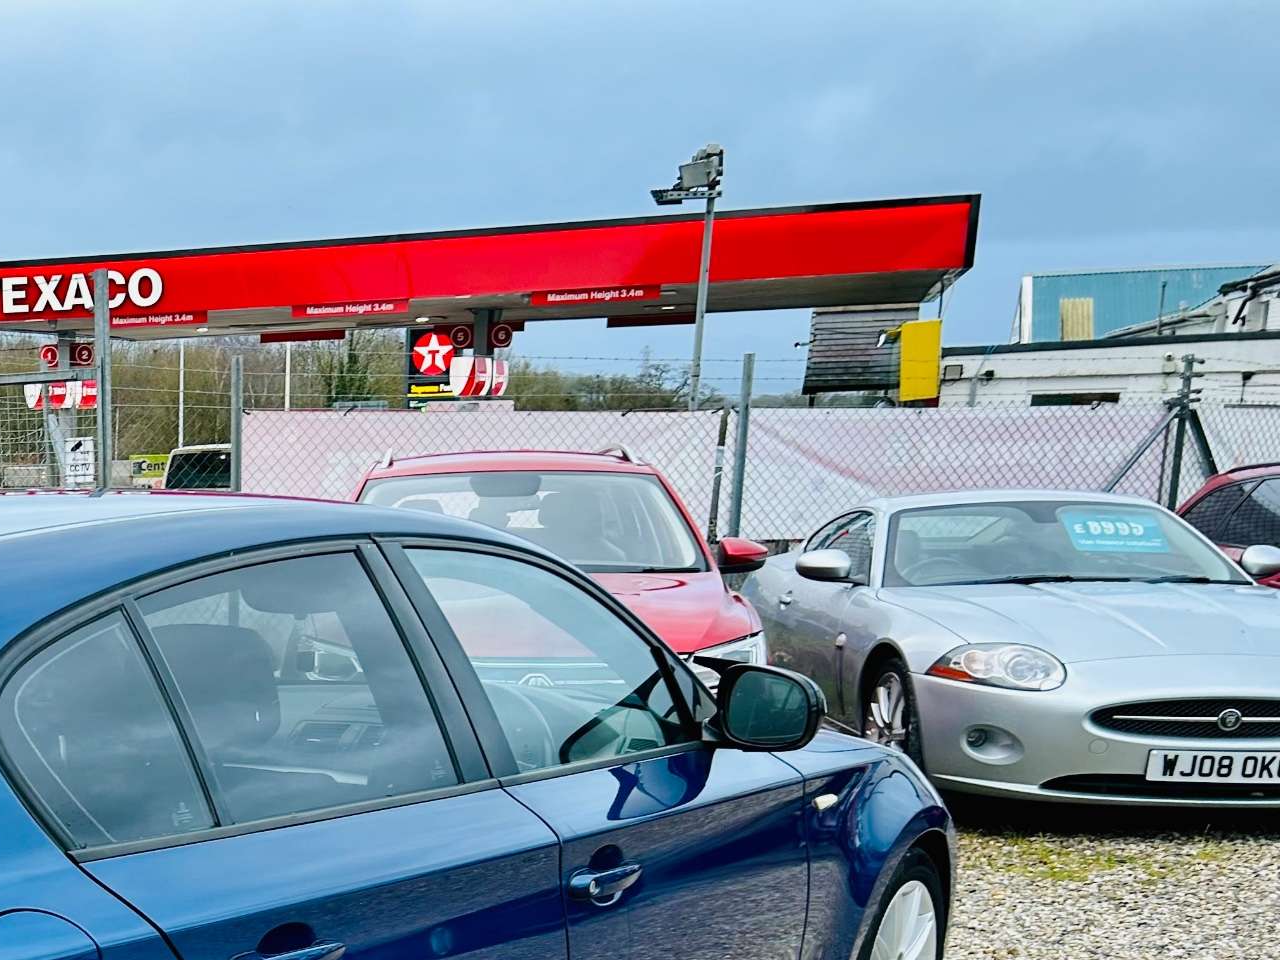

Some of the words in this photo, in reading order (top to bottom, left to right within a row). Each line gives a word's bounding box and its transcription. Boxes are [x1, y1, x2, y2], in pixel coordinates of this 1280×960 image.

[547, 293, 588, 302] Maximum
[591, 291, 620, 300] Height
[621, 289, 644, 297] 3.4m
[306, 305, 343, 315] Maximum
[345, 304, 372, 314] Height
[373, 303, 394, 311] 3.4m
[112, 315, 147, 325] Maximum
[148, 315, 173, 324] Height
[174, 314, 193, 322] 3.4m
[69, 463, 90, 472] CCTV
[1162, 754, 1234, 778] WJ08
[1241, 755, 1280, 779] OK
